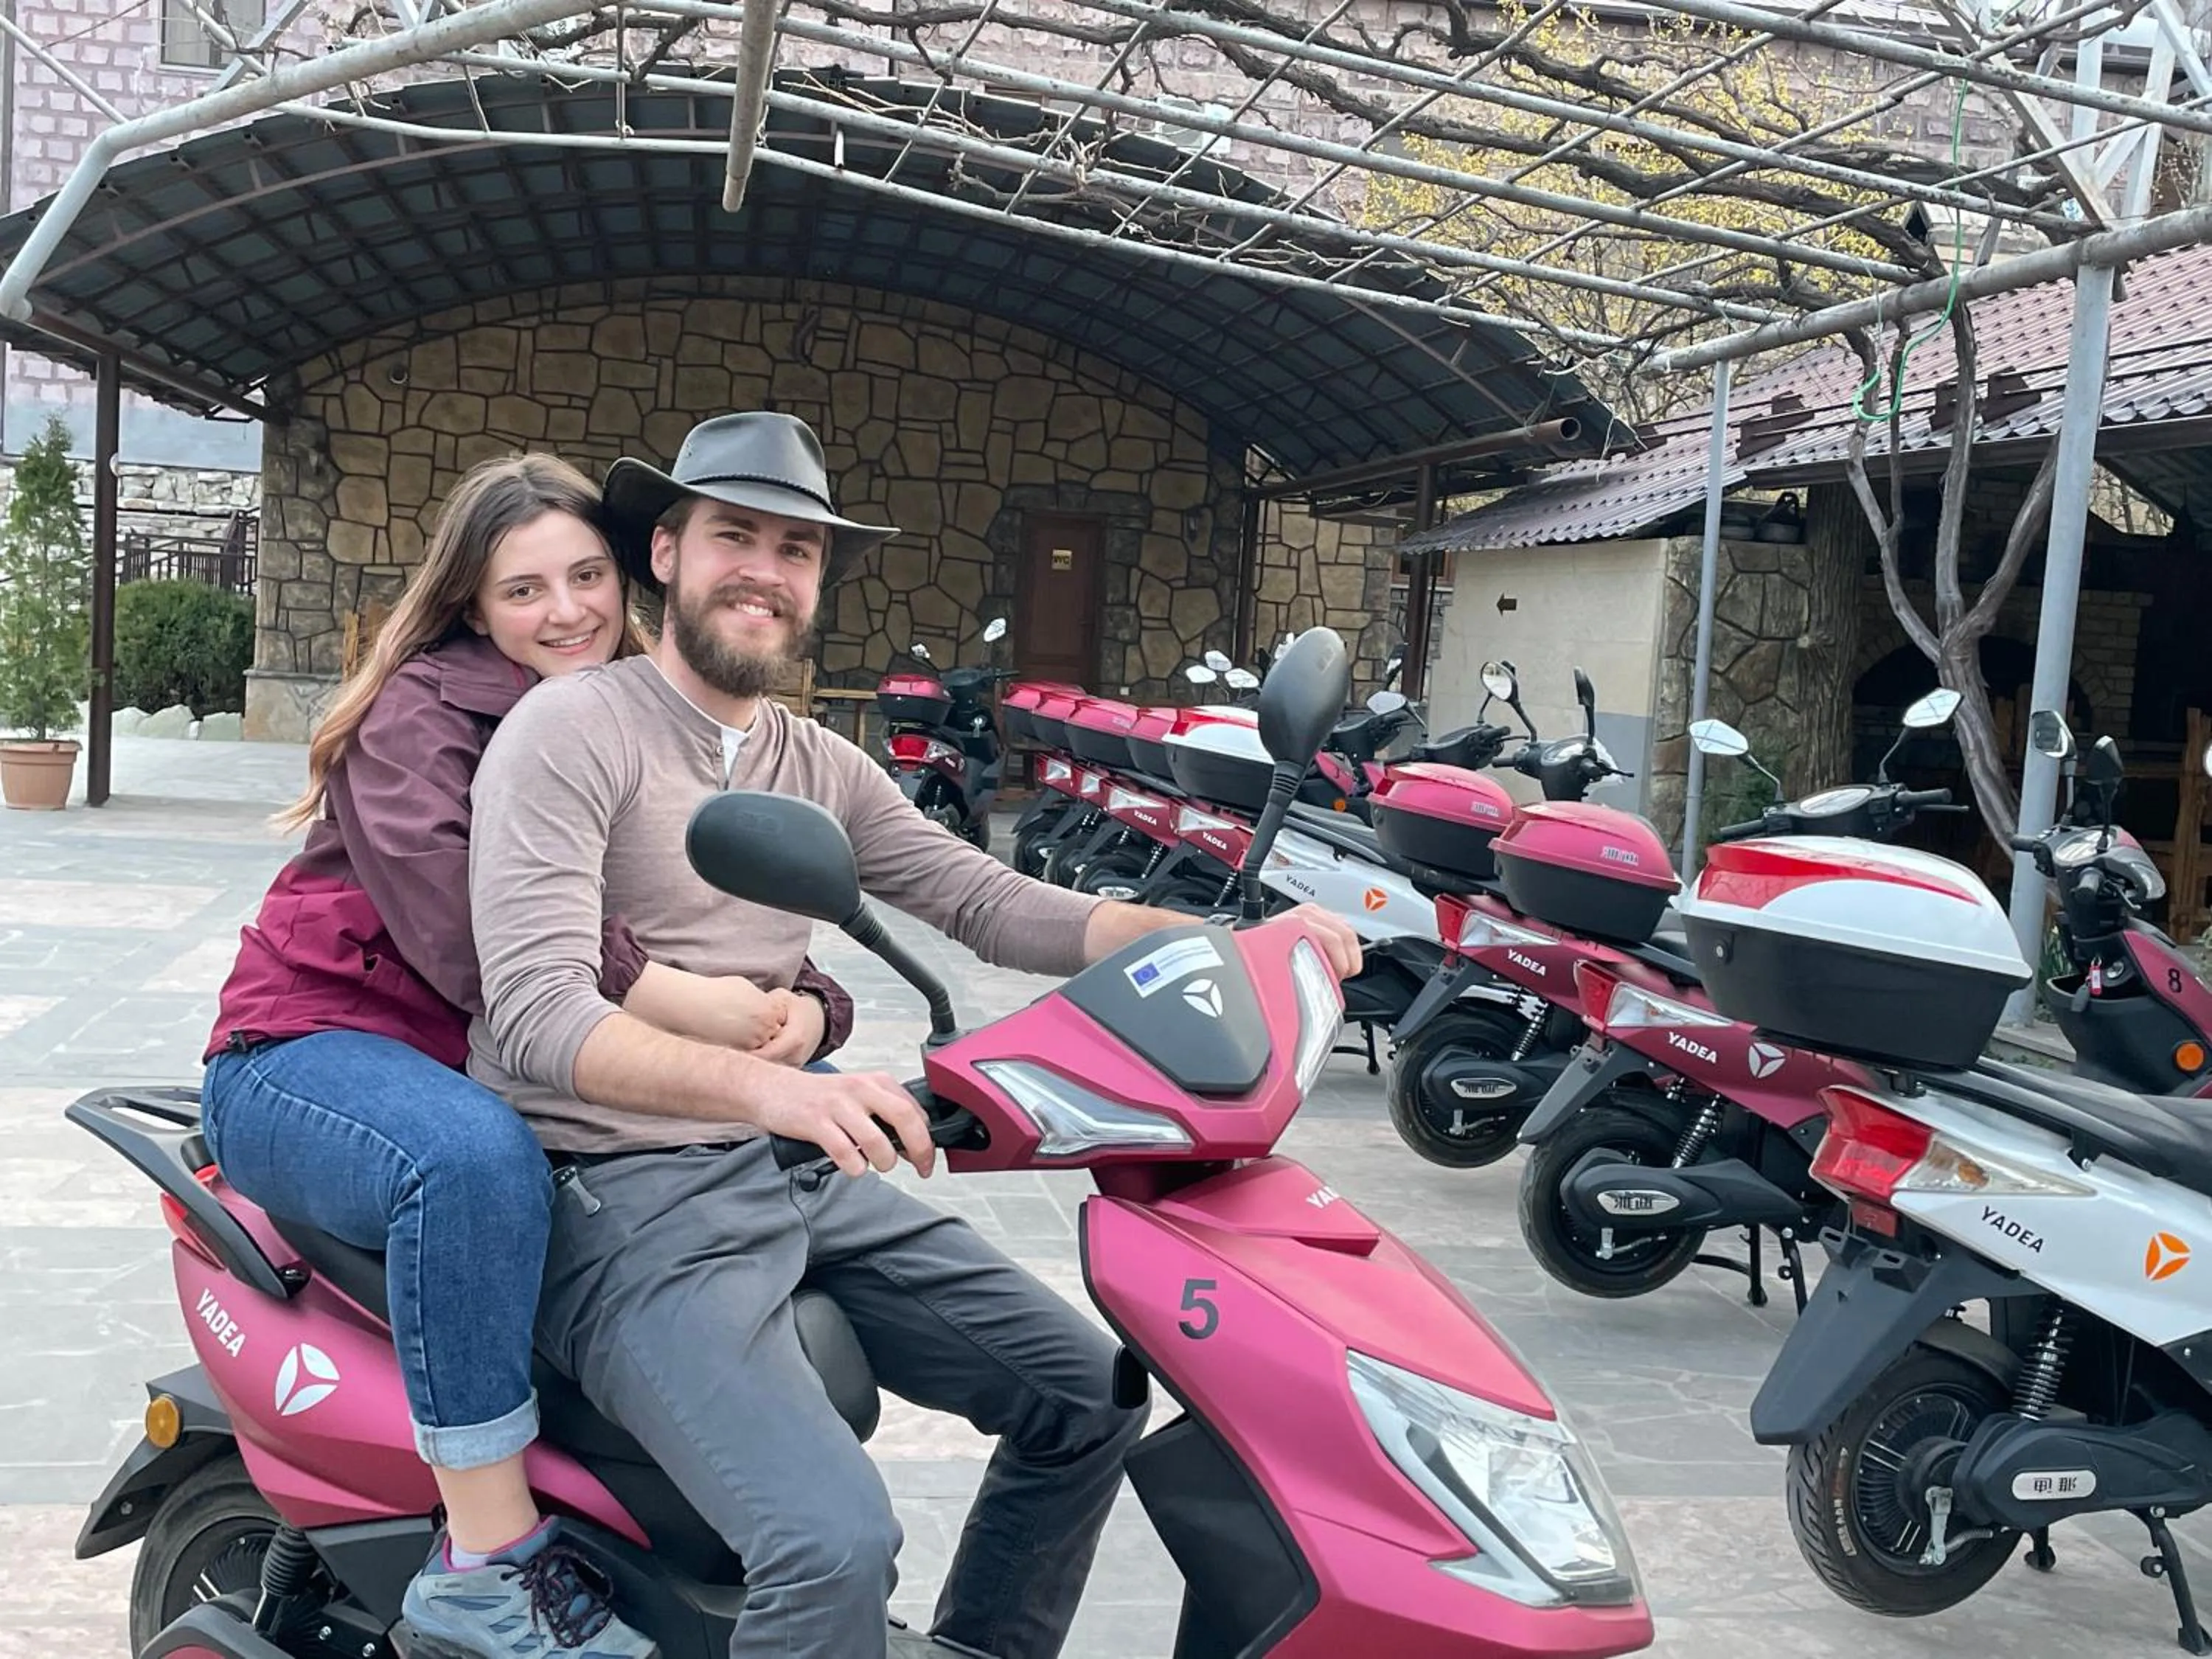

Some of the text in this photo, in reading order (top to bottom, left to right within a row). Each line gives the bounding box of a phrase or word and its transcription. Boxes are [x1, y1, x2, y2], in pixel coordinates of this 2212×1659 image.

[1134, 810, 1157, 826] YADEA
[1203, 831, 1228, 850] YADEA
[1287, 874, 1315, 897] YADEA
[1508, 949, 1546, 976] YADEA
[2168, 967, 2183, 993] 8
[1669, 1032, 1717, 1063] YADEA
[1981, 1206, 2043, 1253] YADEA
[196, 1287, 246, 1357] YADEA
[1179, 1279, 1219, 1339] 5
